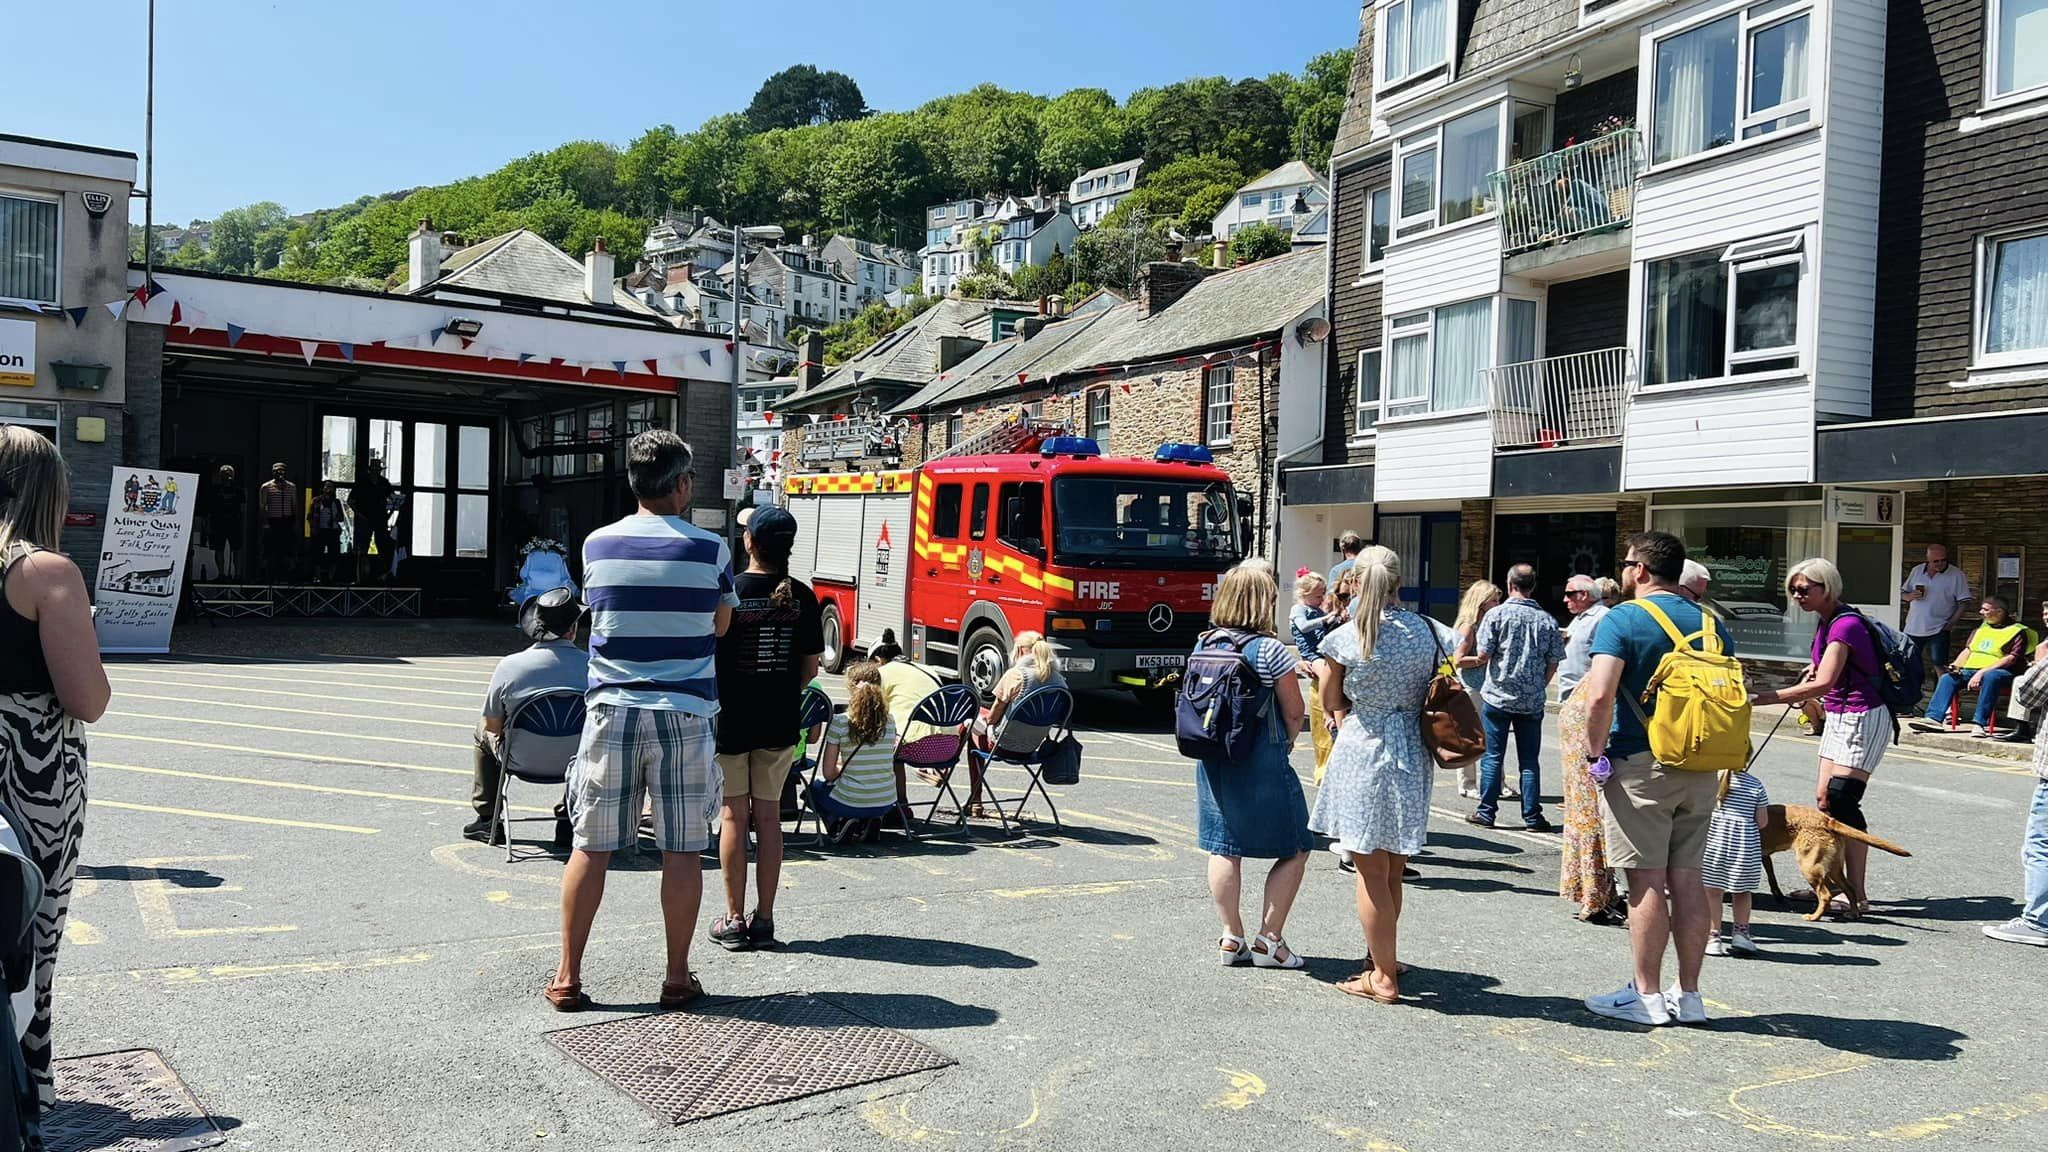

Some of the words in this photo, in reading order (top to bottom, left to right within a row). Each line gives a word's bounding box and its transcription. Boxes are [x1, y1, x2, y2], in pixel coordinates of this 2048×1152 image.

[113, 517, 148, 526] Miner
[150, 519, 181, 531] Quay
[137, 529, 170, 540] Shanty
[120, 539, 141, 549] Folk
[143, 541, 171, 553] Group
[1078, 582, 1120, 600] FIRE
[1139, 656, 1162, 667] WK53
